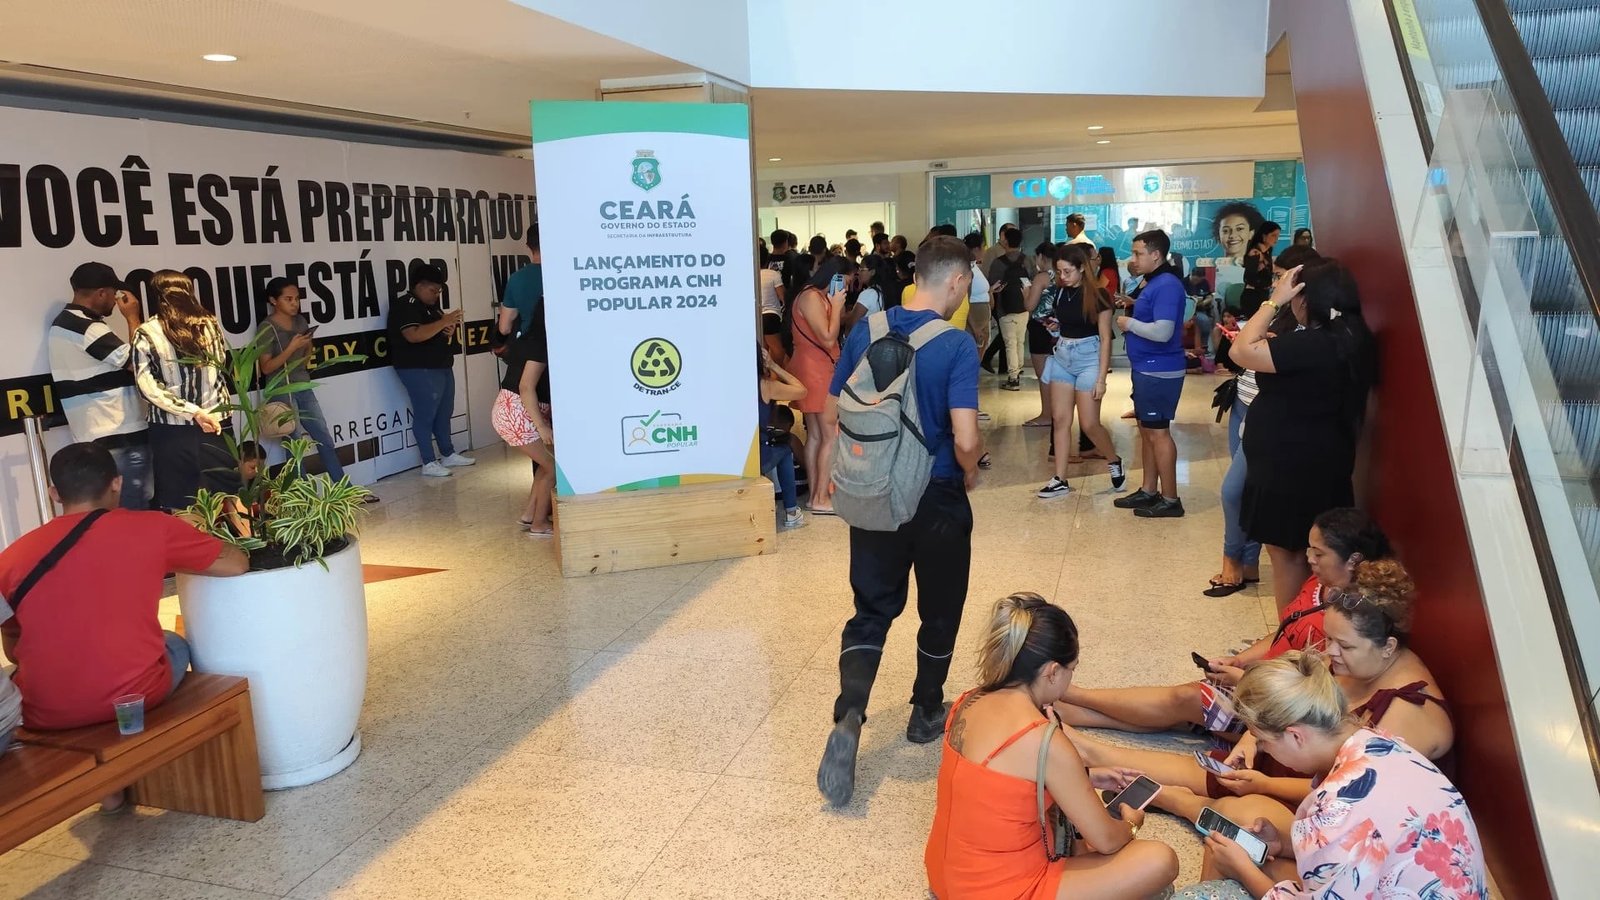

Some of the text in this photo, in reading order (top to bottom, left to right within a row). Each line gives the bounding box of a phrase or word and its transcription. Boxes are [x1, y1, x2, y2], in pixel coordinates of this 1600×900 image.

[790, 180, 836, 195] CEARÁ
[168, 165, 292, 246] ESTÁ
[600, 193, 696, 220] CEARÁ
[600, 222, 645, 230] GOVERNO
[662, 221, 696, 229] ESTADO
[573, 253, 726, 274] LANÇAMENTO DO
[580, 274, 722, 291] PROGRAMA CNH
[587, 294, 718, 312] POPULAR 2024
[633, 380, 681, 396] DETRAN-CE
[652, 425, 698, 443] CNH
